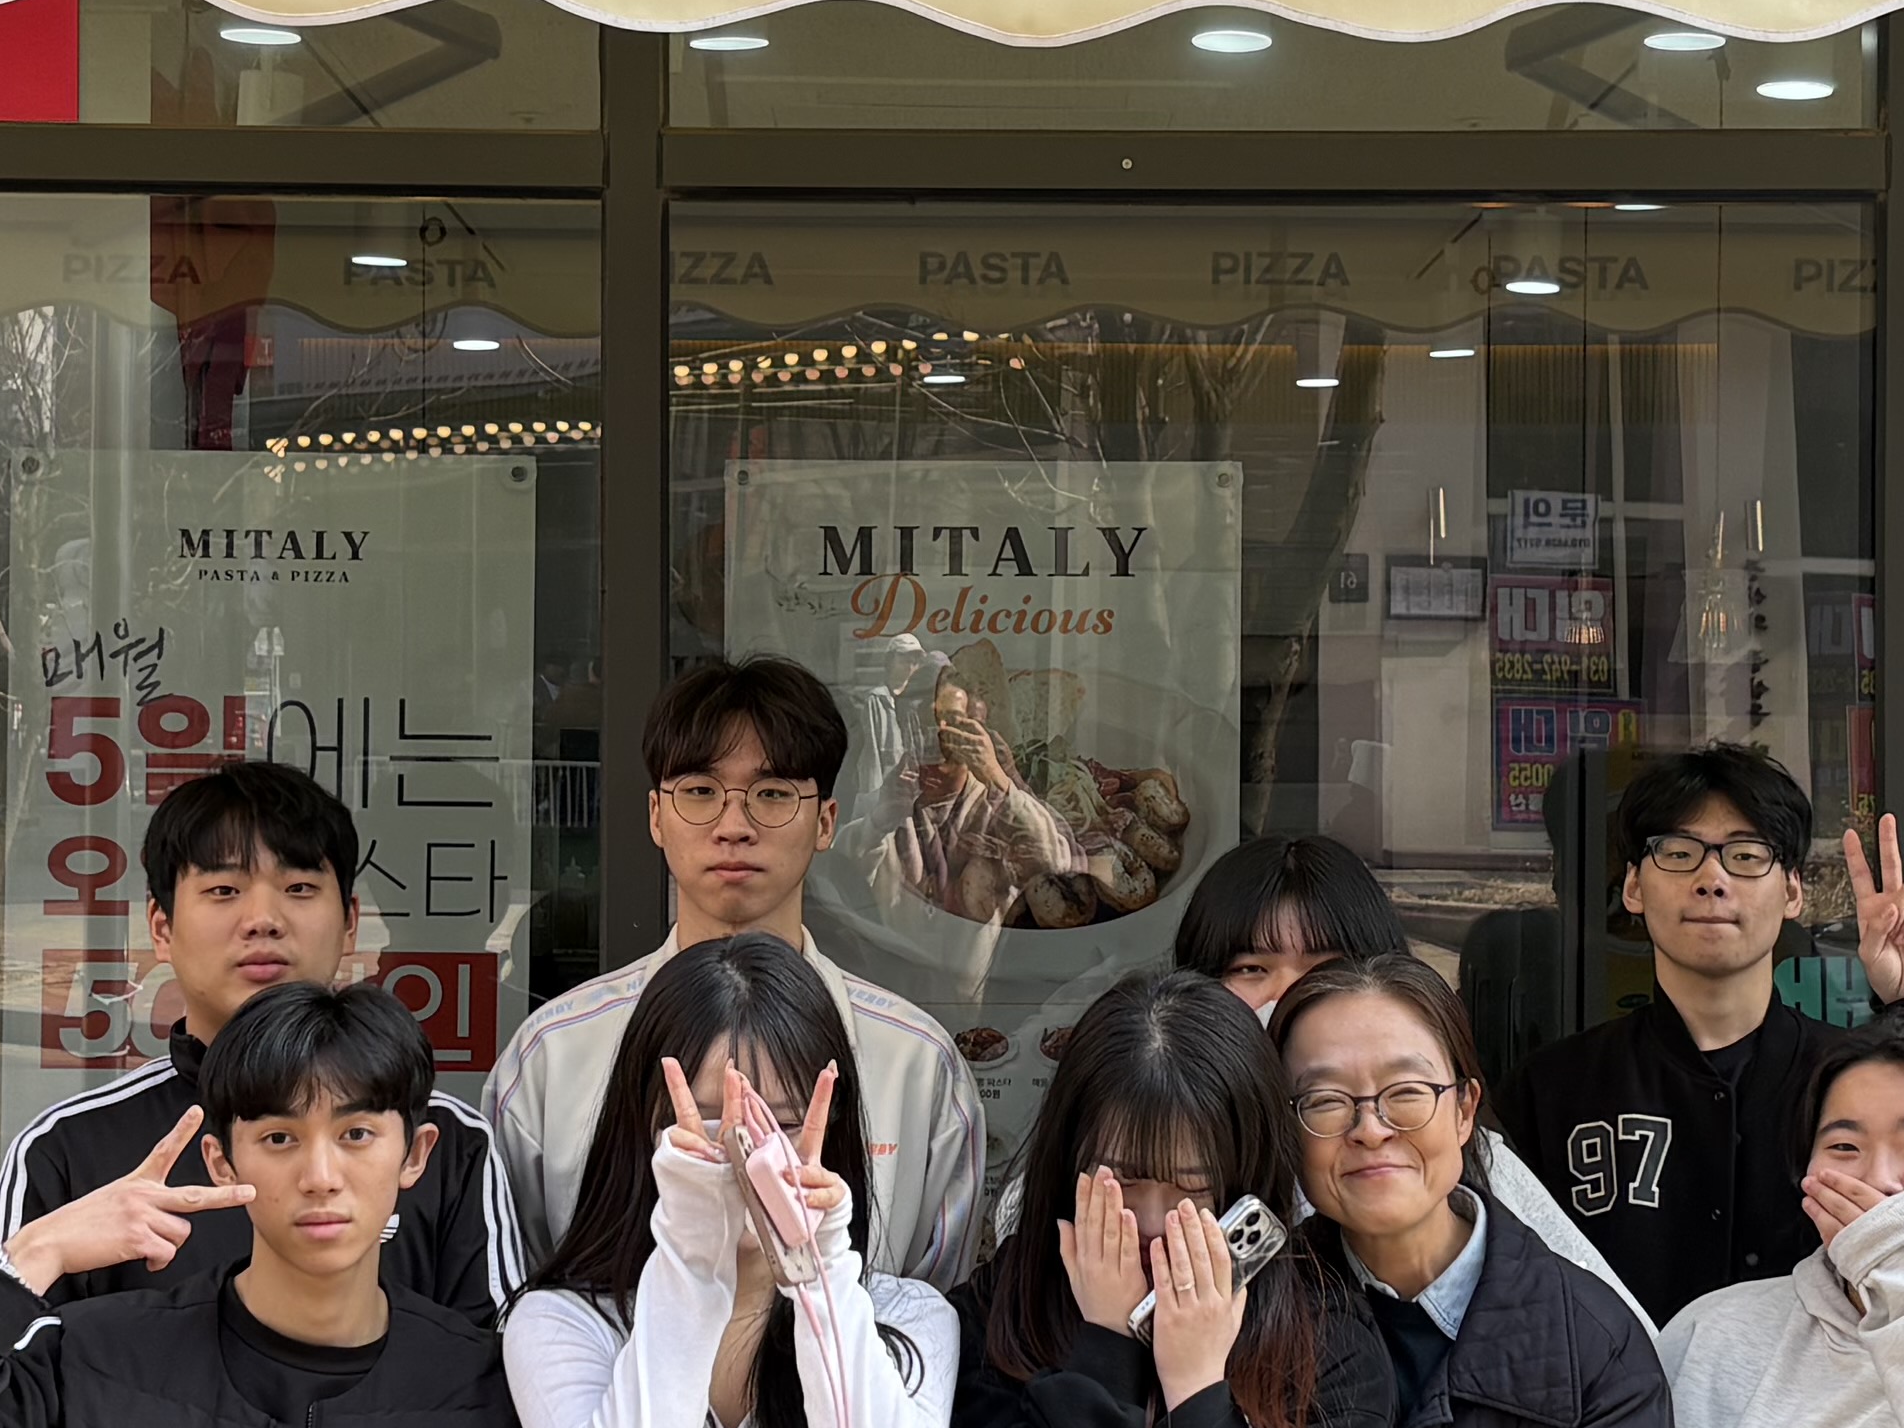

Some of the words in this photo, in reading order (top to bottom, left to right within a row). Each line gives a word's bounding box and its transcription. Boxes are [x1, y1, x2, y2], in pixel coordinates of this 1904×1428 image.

[62, 253, 201, 286] PIZZA
[669, 251, 774, 286] IZZA
[918, 251, 1070, 287] PASTA
[1211, 251, 1351, 287] PIZZA
[178, 528, 370, 561] MITALY
[818, 525, 1149, 578] MITALY
[198, 569, 260, 582] PASTA
[291, 570, 349, 583] PIZZA
[851, 572, 1115, 640] Delicious
[41, 618, 174, 707] 매월
[980, 1090, 1001, 1099] 00원
[1567, 1113, 1672, 1217] 97
